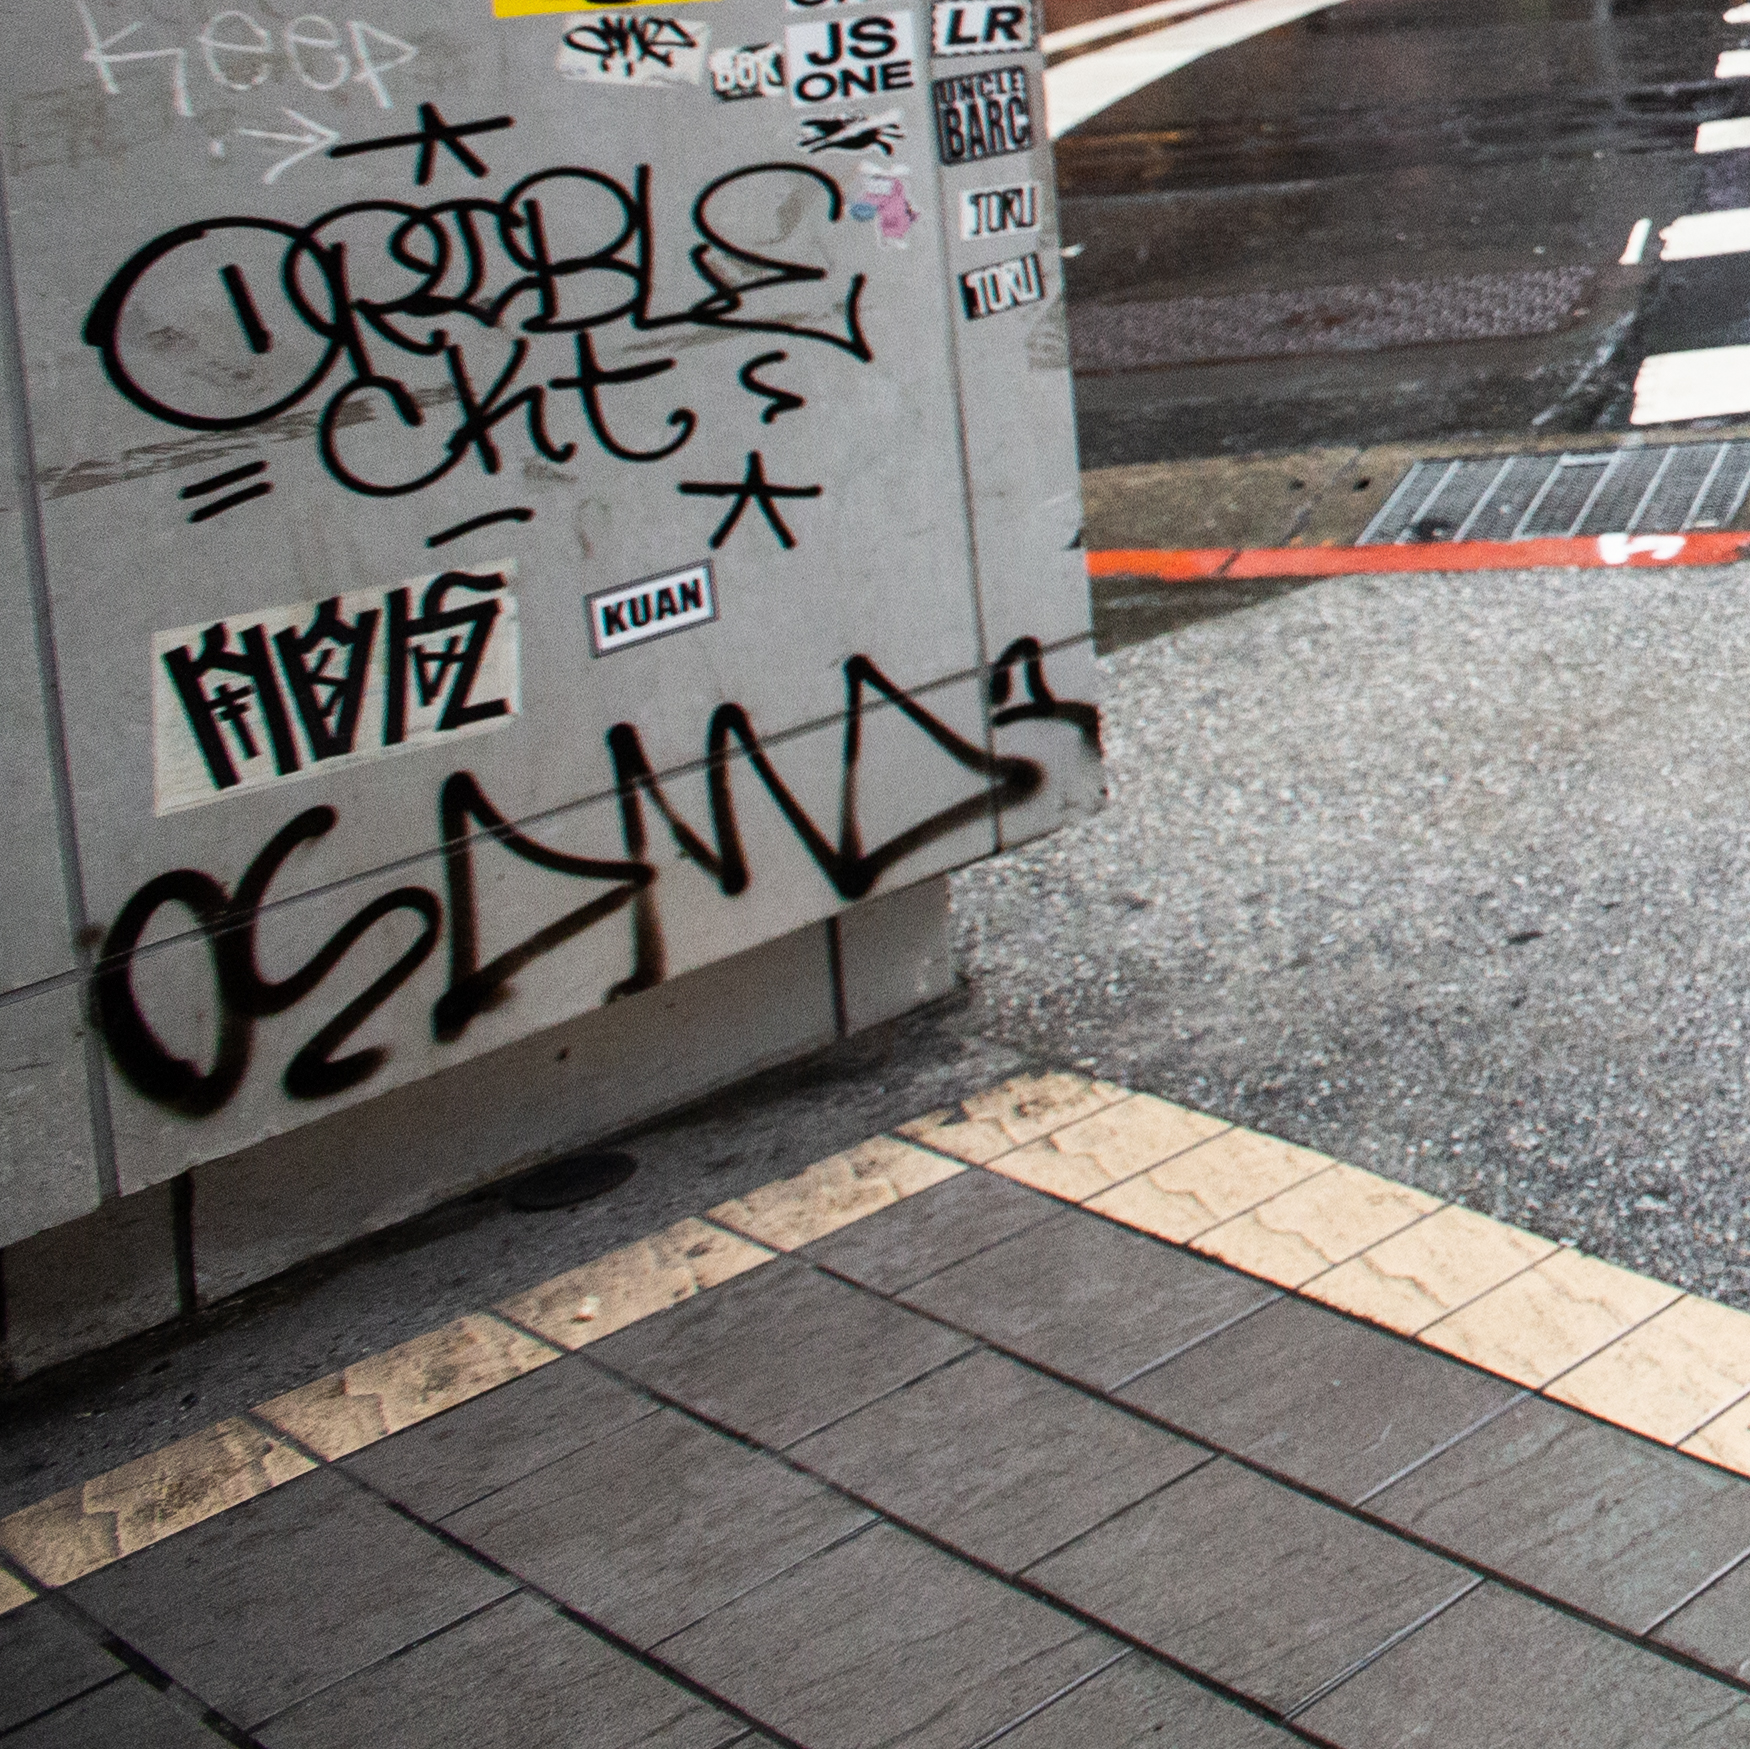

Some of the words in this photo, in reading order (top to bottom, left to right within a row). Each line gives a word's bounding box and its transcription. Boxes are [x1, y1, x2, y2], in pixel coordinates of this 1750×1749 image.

[805, 17, 898, 67] JS
[944, 4, 1025, 46] LR
[795, 60, 914, 101] ONE
[602, 577, 705, 637] KUAN
